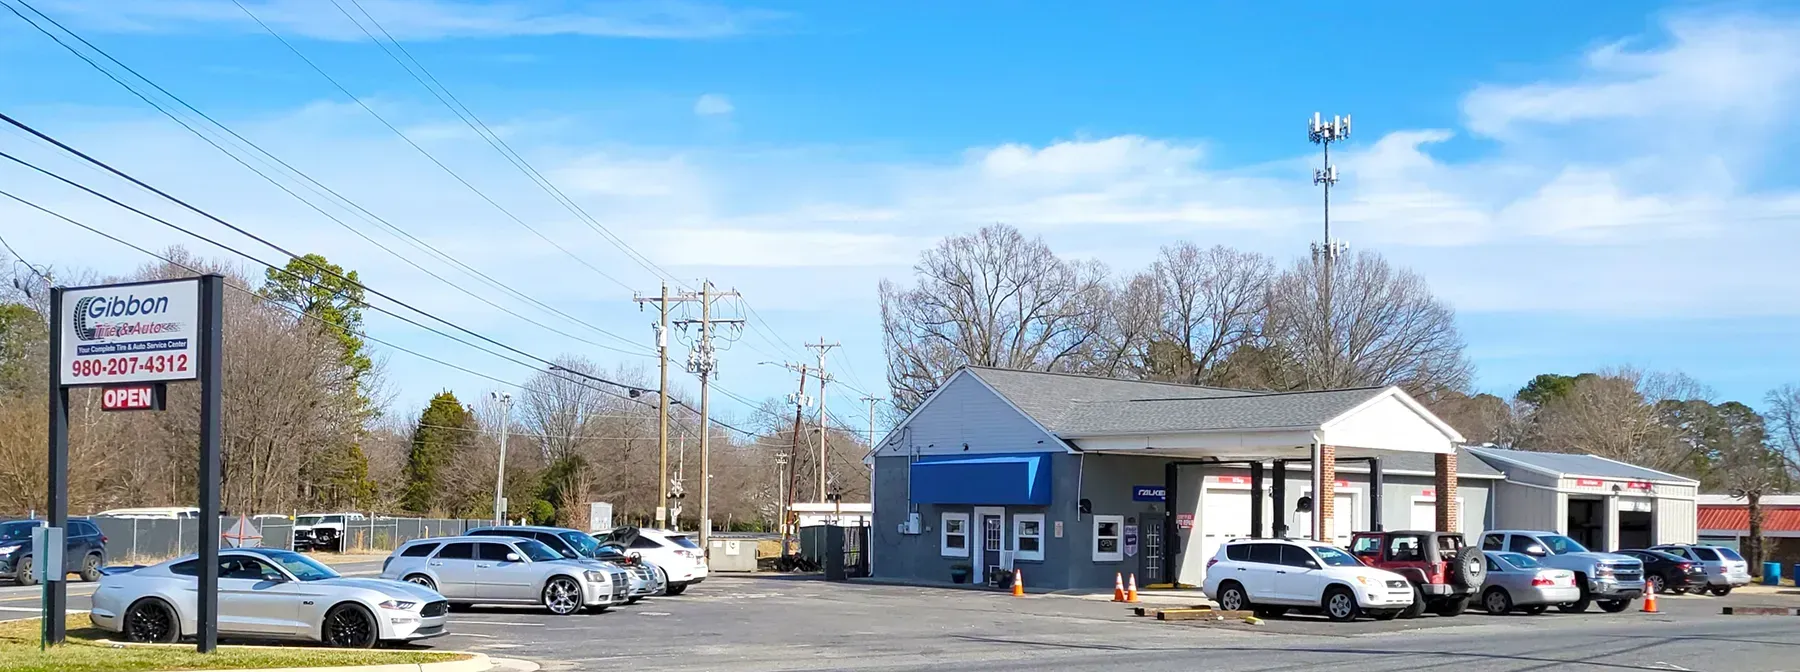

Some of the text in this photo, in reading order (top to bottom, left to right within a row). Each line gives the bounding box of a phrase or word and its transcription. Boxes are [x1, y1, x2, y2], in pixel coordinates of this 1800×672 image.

[88, 295, 168, 318] Gibbon
[94, 322, 161, 338] Tire & Auto
[78, 346, 90, 354] Your
[90, 345, 116, 353] Complete
[146, 341, 167, 349] Service
[167, 340, 187, 348] Center
[72, 354, 188, 377] 980-207-4312
[103, 388, 152, 408] OPEN
